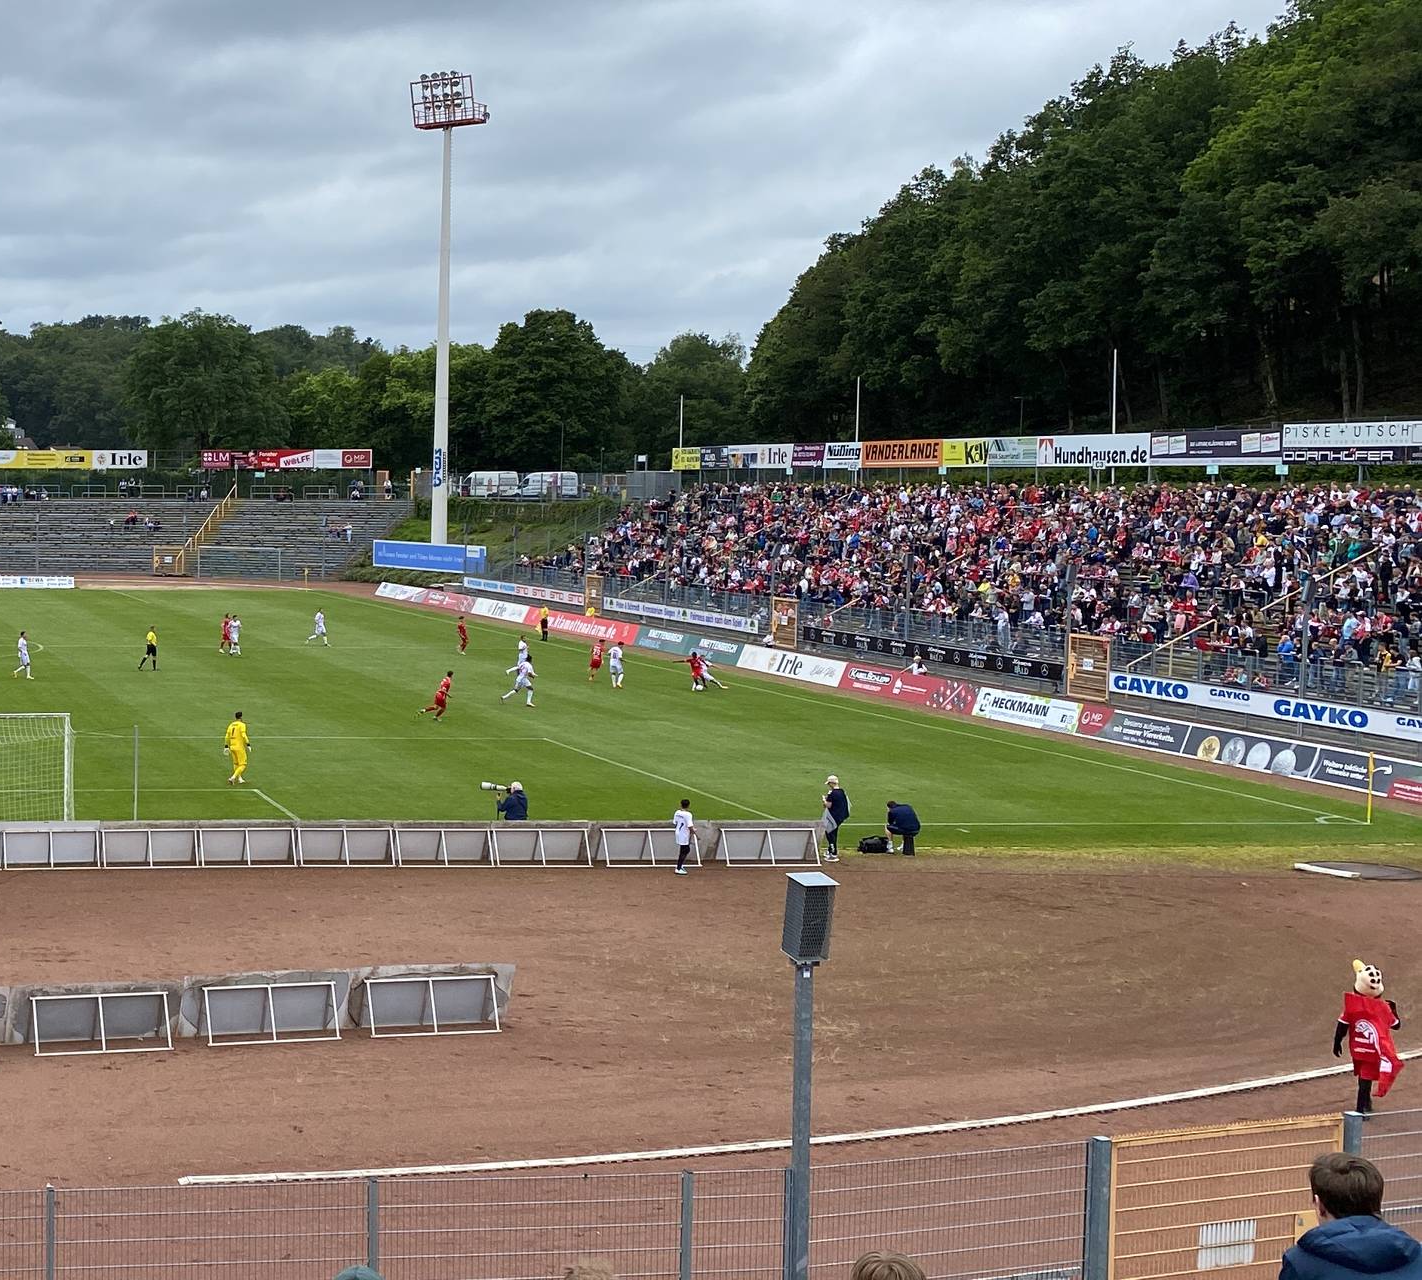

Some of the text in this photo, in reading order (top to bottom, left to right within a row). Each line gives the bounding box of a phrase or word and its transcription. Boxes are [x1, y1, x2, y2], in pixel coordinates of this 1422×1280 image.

[1285, 426, 1331, 438] PISKE
[1354, 425, 1409, 437] UTSCH
[111, 453, 142, 465] Irle
[213, 452, 229, 461] LM
[768, 448, 787, 464] Irle
[865, 443, 939, 460] VANDERLANDE
[1054, 445, 1147, 464] Hundhausen.de
[492, 602, 506, 617] Irle
[776, 654, 803, 676] Irle
[1114, 675, 1188, 699] GAYKO
[1210, 689, 1250, 701] GAYKO
[991, 697, 1049, 717] HECKMANN
[1274, 699, 1368, 728] GAYKO
[1090, 712, 1103, 722] MP
